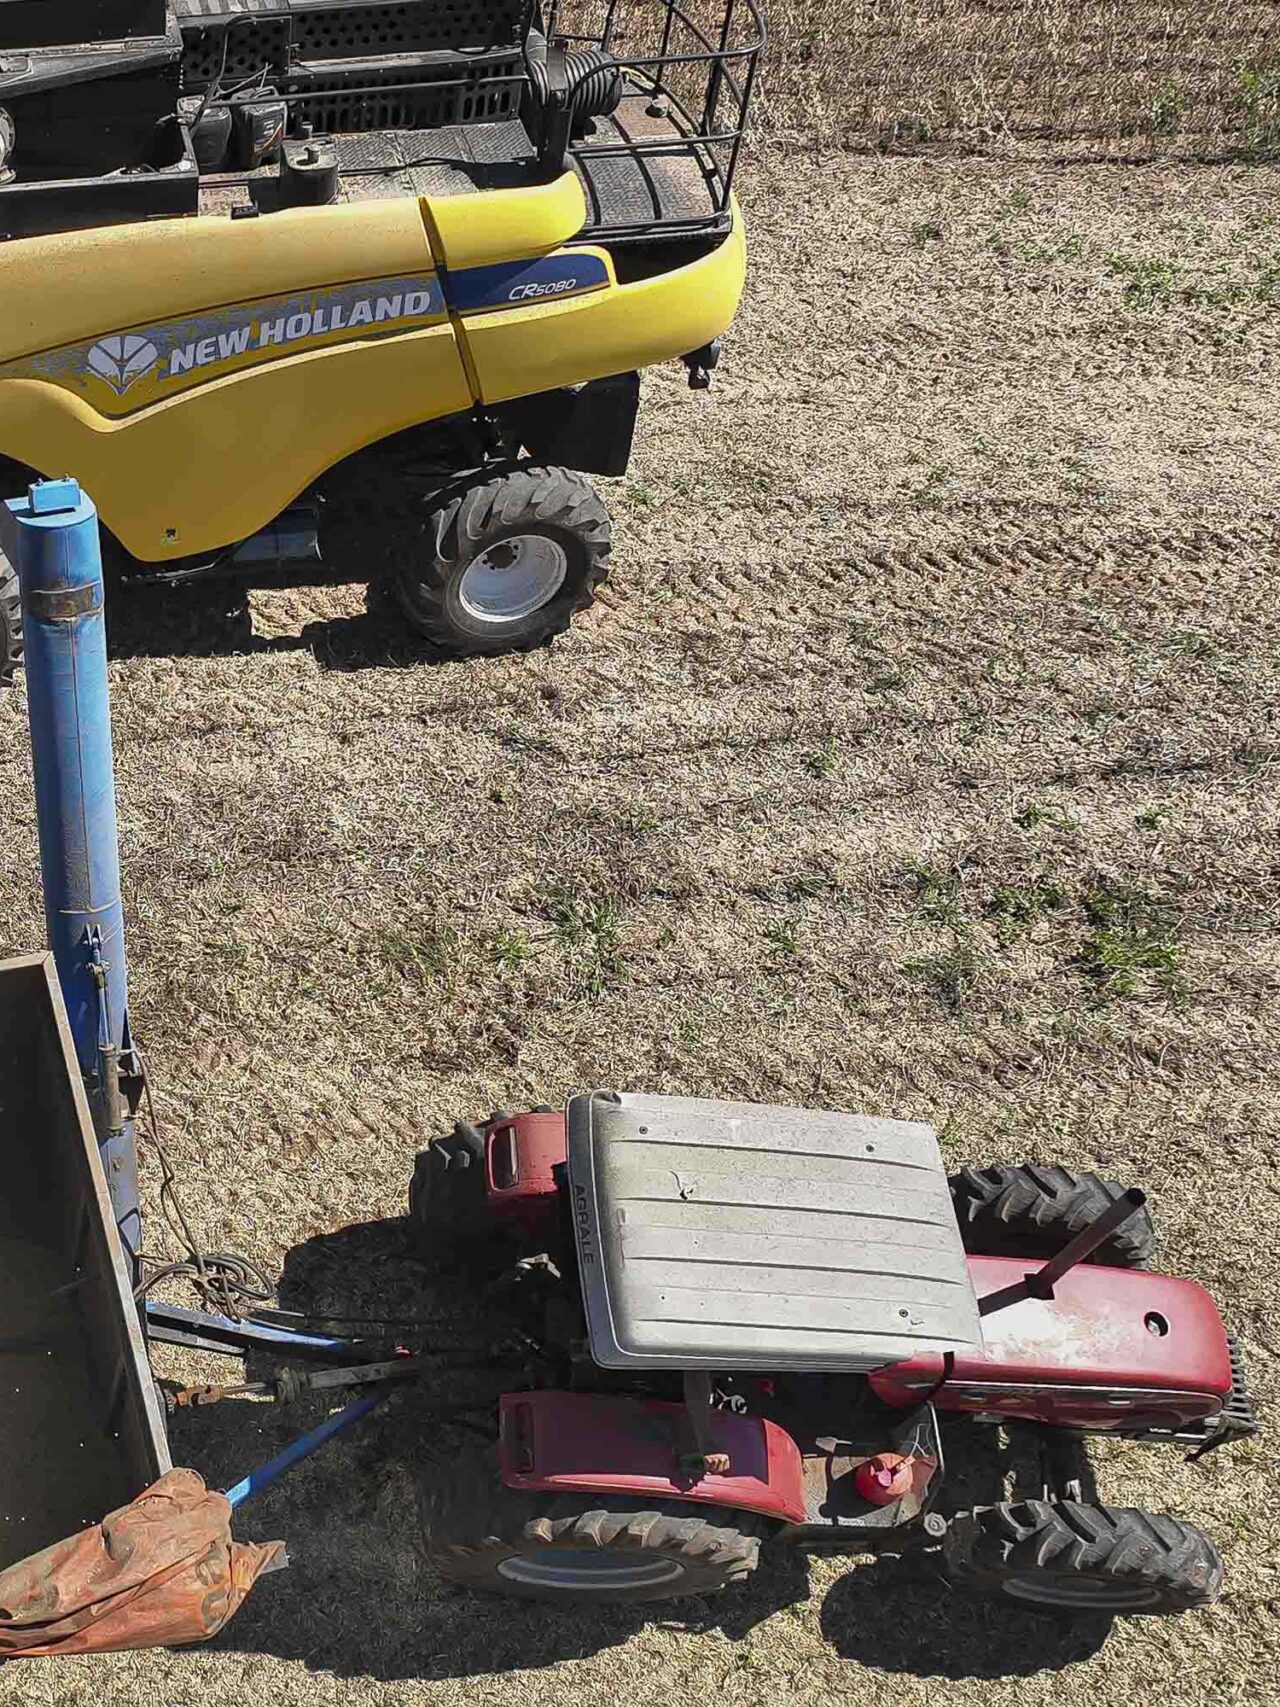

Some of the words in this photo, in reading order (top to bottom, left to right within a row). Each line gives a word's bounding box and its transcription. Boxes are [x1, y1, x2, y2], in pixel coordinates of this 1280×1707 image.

[508, 278, 577, 300] CR5080
[170, 326, 251, 375] NEW
[256, 291, 431, 347] HOLLAND
[574, 1184, 594, 1265] AGRALE
